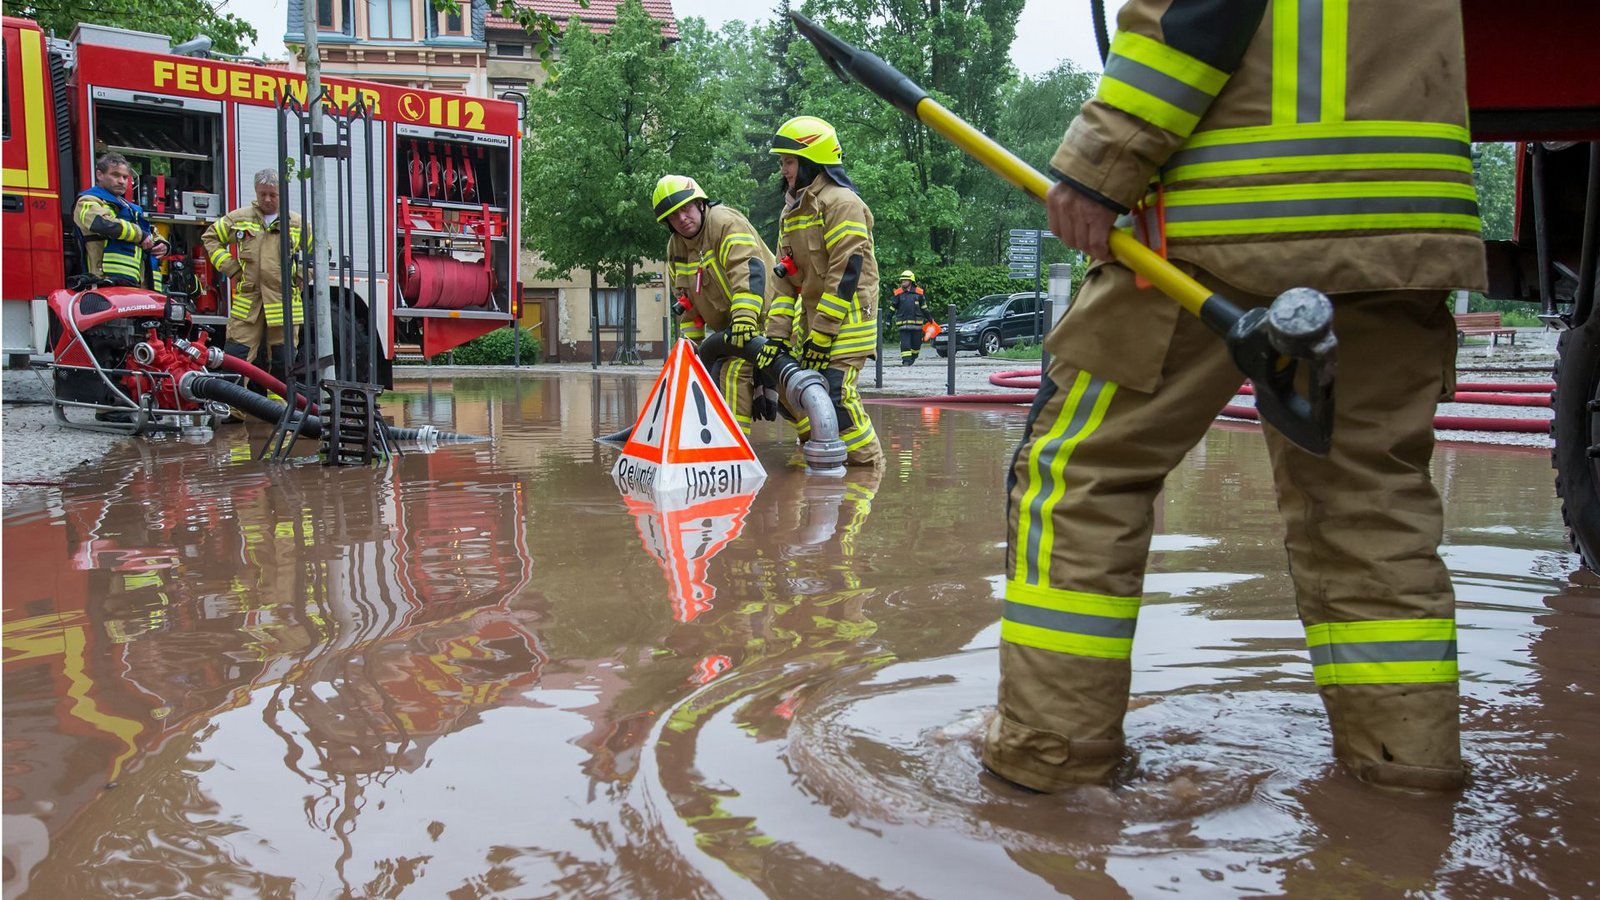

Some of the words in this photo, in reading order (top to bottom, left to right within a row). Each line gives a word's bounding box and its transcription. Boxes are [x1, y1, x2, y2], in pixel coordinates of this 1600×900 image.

[429, 97, 485, 130] 112
[477, 136, 507, 145] MAGIRUS
[32, 200, 47, 210] 42
[117, 304, 157, 313] MAGIRUS
[685, 464, 742, 487] Unfall
